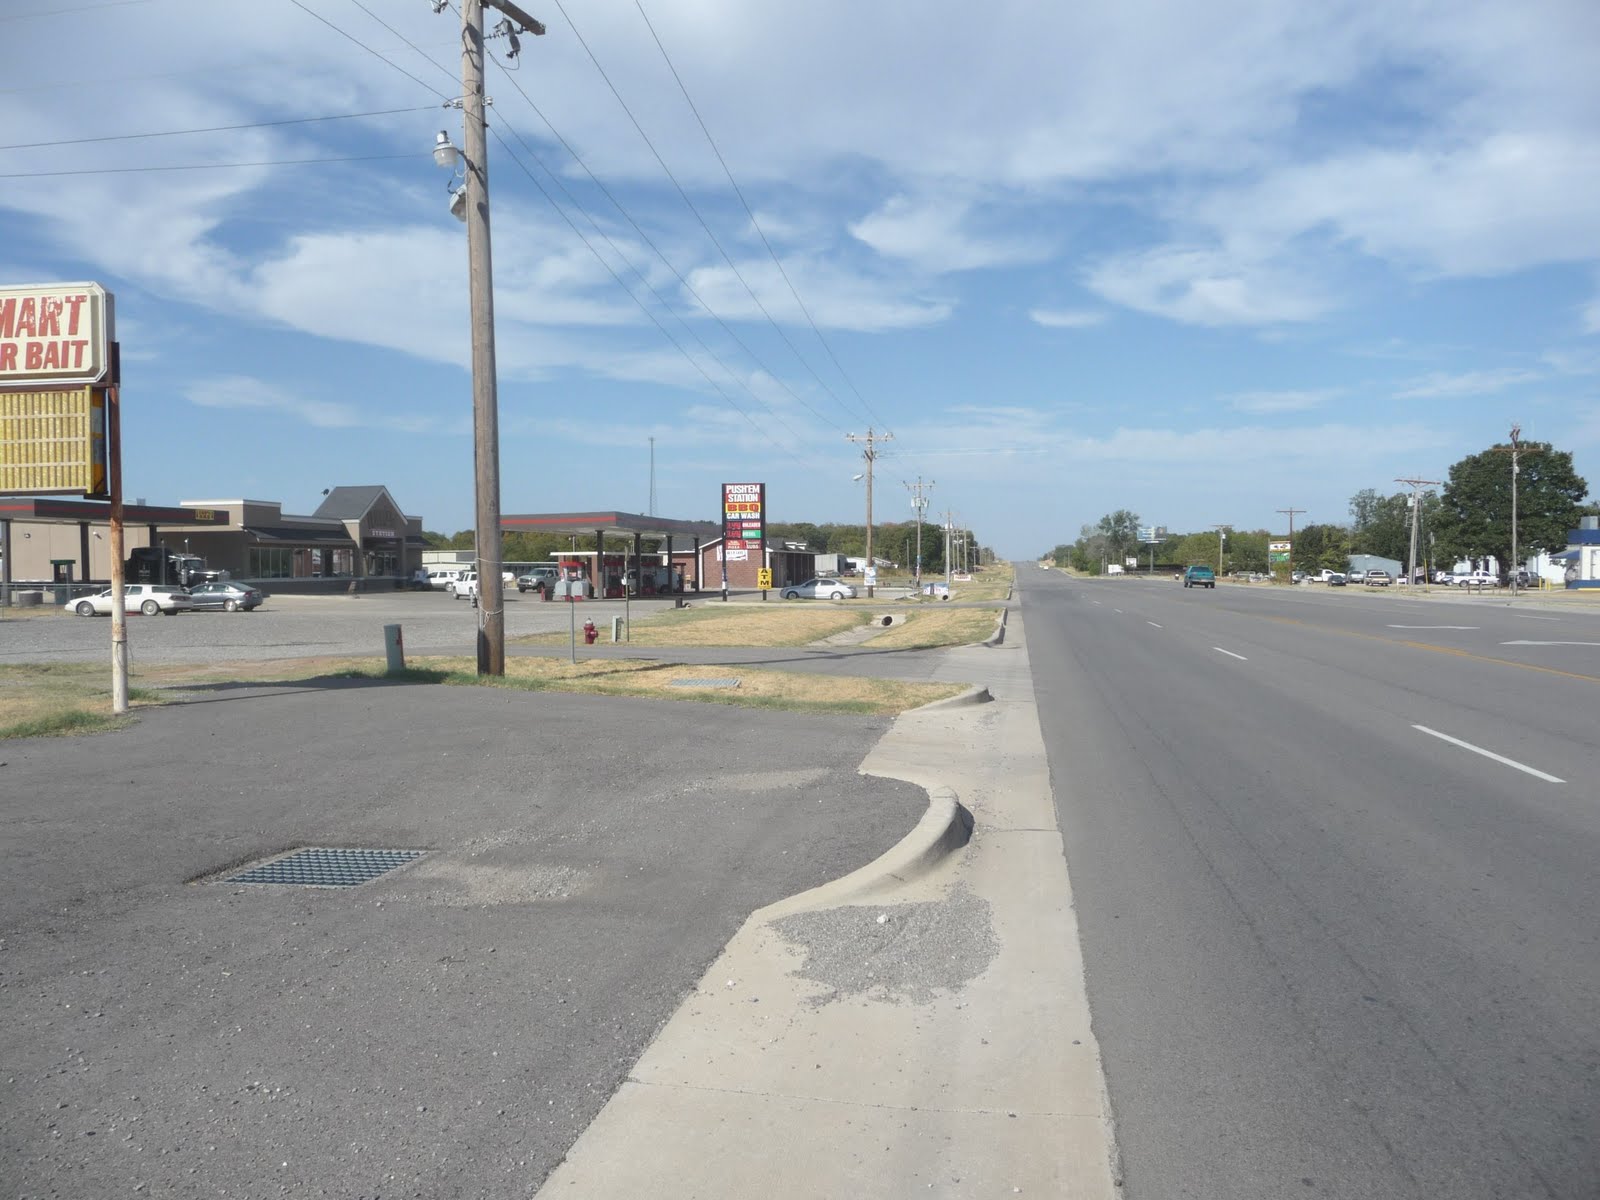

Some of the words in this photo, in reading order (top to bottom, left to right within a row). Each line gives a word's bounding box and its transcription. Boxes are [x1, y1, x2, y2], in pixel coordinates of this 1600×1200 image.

[25, 340, 88, 370] BAIT
[728, 494, 758, 502] STATION
[727, 504, 758, 512] BBQ
[760, 569, 769, 586] ATM
